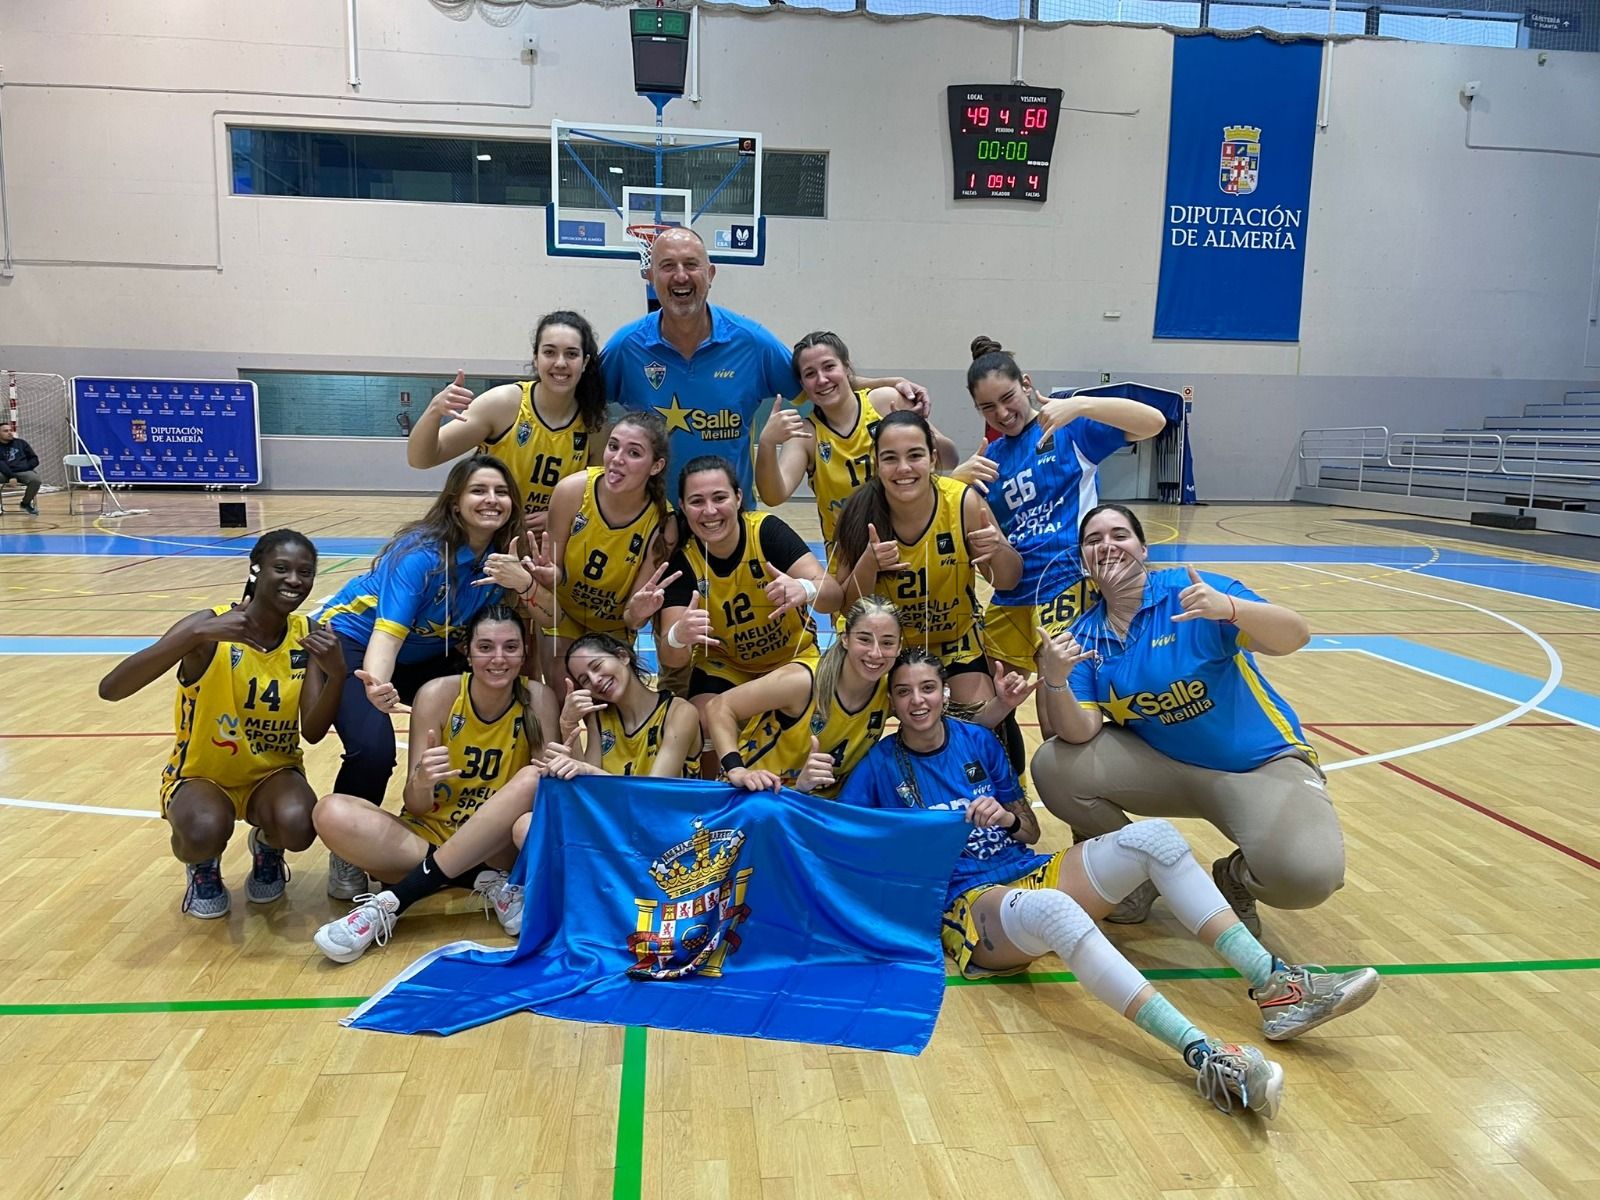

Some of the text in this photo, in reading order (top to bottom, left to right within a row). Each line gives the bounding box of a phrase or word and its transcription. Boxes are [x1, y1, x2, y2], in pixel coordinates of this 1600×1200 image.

[967, 107, 1048, 128] 49 4 60
[978, 141, 1028, 160] 00:00
[1028, 176, 1038, 189] 4
[1170, 204, 1302, 228] DIPUTACIÓN
[1172, 228, 1296, 250] DE ALMERÍA
[714, 368, 736, 378] vive
[691, 410, 740, 429] Salle
[150, 426, 203, 435] DIPUTACIÓN
[166, 434, 203, 443] ALMERÍA
[701, 429, 740, 440] Melilla
[530, 454, 562, 487] 16
[846, 454, 872, 487] 17
[1038, 455, 1056, 466] vive
[1002, 468, 1037, 510] 26
[583, 549, 608, 580] 8
[897, 566, 929, 599] 21
[722, 592, 755, 627] 12
[902, 598, 959, 612] MELILLA
[1041, 594, 1076, 626] 26
[903, 611, 950, 623] SPORT
[734, 613, 785, 643] MELILLA
[737, 627, 782, 652] SPORT
[1151, 633, 1176, 648] vive
[244, 677, 280, 711] 14
[1136, 680, 1205, 715] Salle
[1159, 699, 1212, 724] Melilla
[244, 717, 299, 731] MELILL
[245, 729, 296, 744] SPORT
[459, 746, 503, 781] 30
[973, 785, 992, 795] vive
